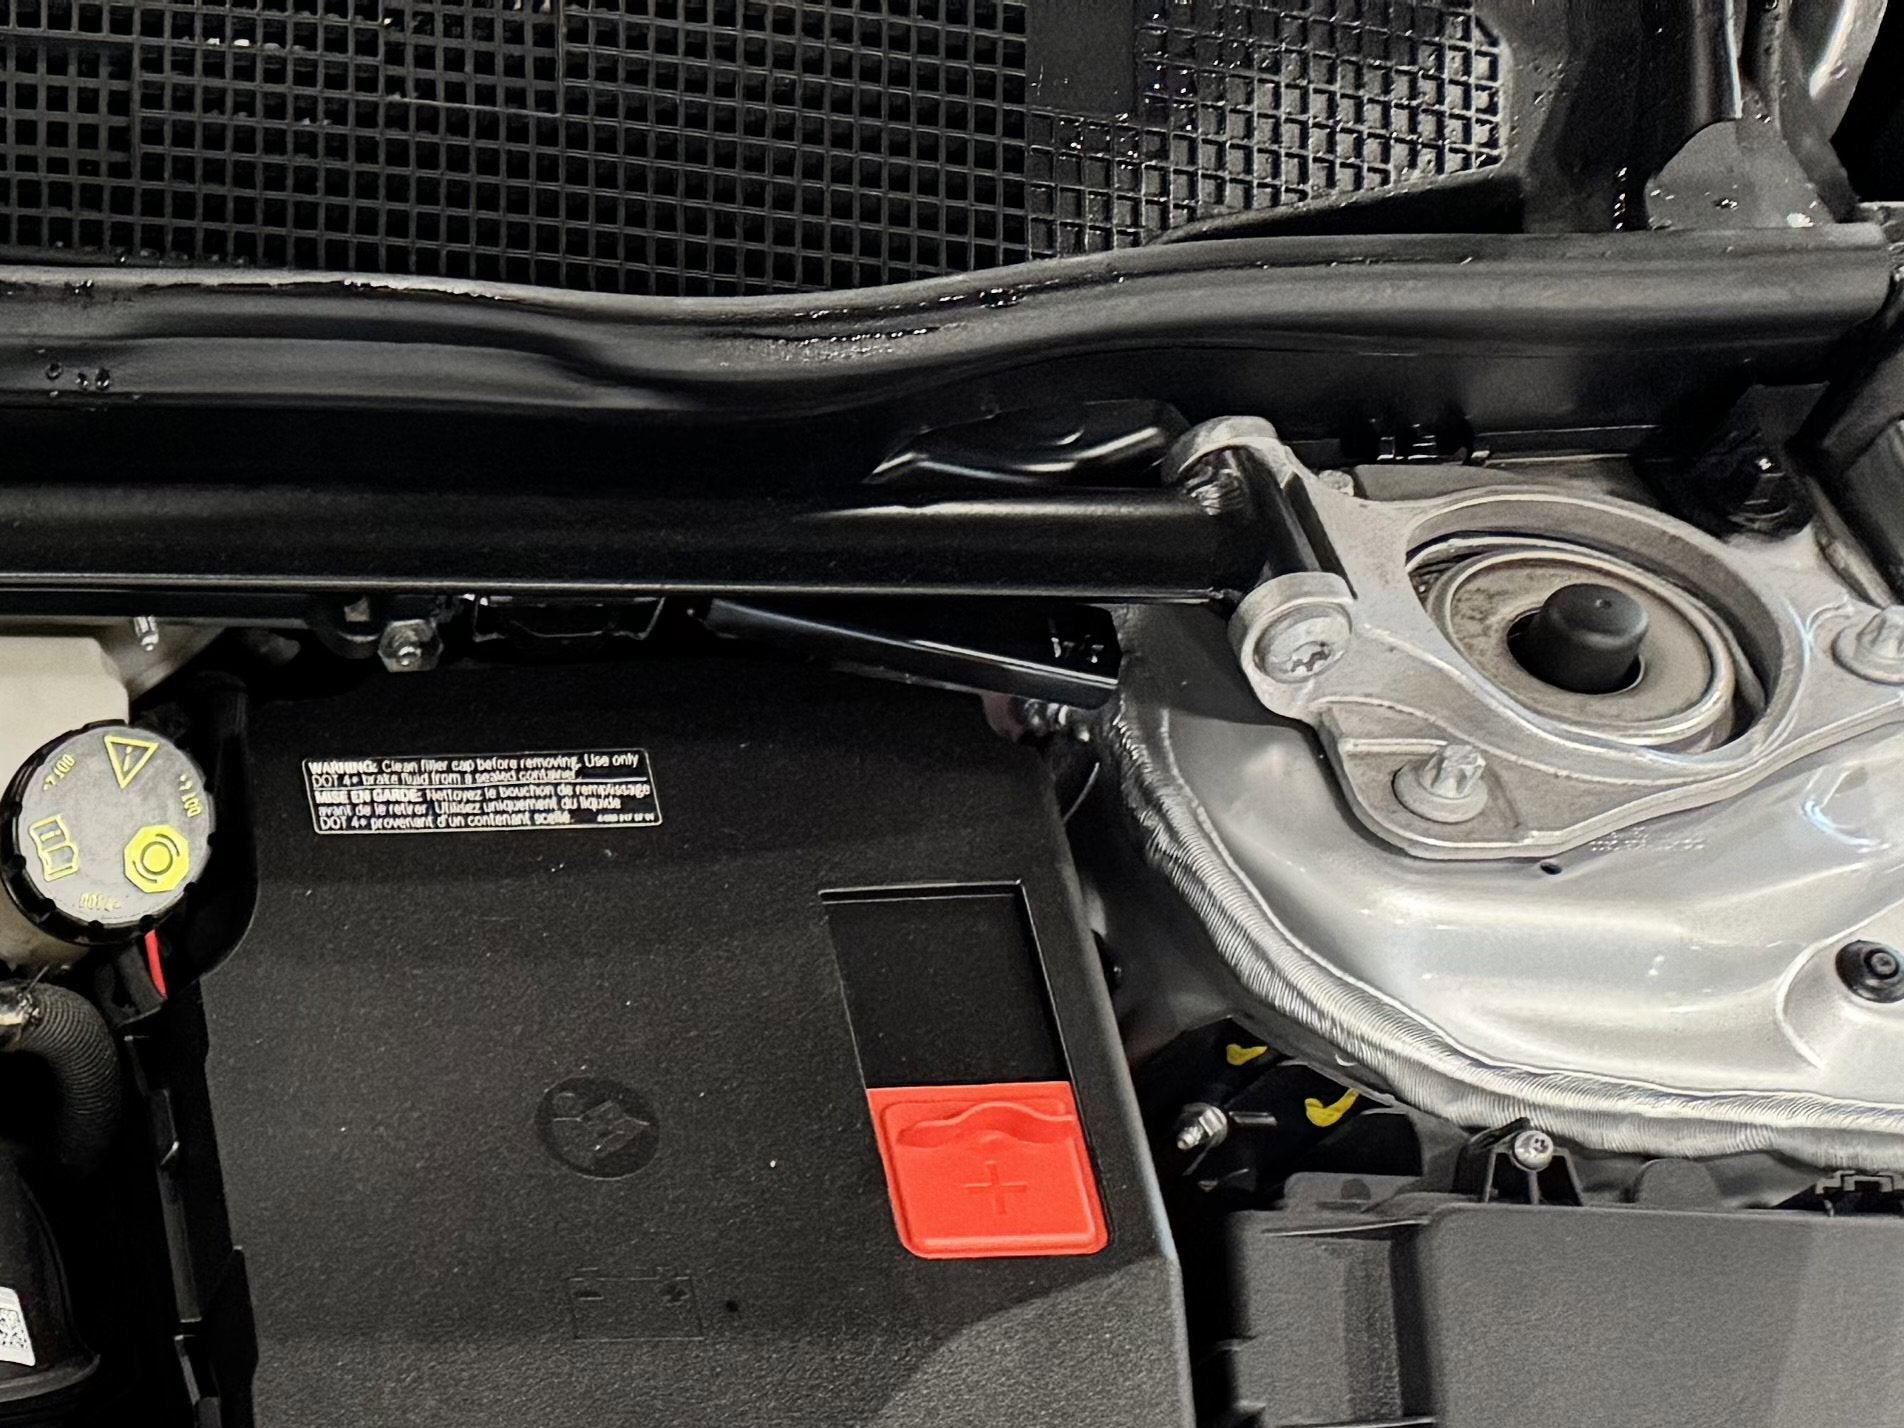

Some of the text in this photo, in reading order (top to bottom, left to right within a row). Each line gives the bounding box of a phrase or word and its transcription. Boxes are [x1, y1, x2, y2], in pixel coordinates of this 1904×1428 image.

[308, 761, 378, 775] WARNING:
[382, 760, 418, 773] Clean
[451, 760, 475, 774] cap
[477, 757, 518, 770] before
[584, 753, 609, 768] Use
[612, 753, 639, 768] only
[312, 774, 339, 788] DOT
[362, 773, 399, 786] brake
[431, 772, 461, 785] from
[351, 790, 371, 803] EN
[499, 784, 554, 798] bouchon
[320, 817, 347, 830] DOT
[370, 816, 434, 831] provenant
